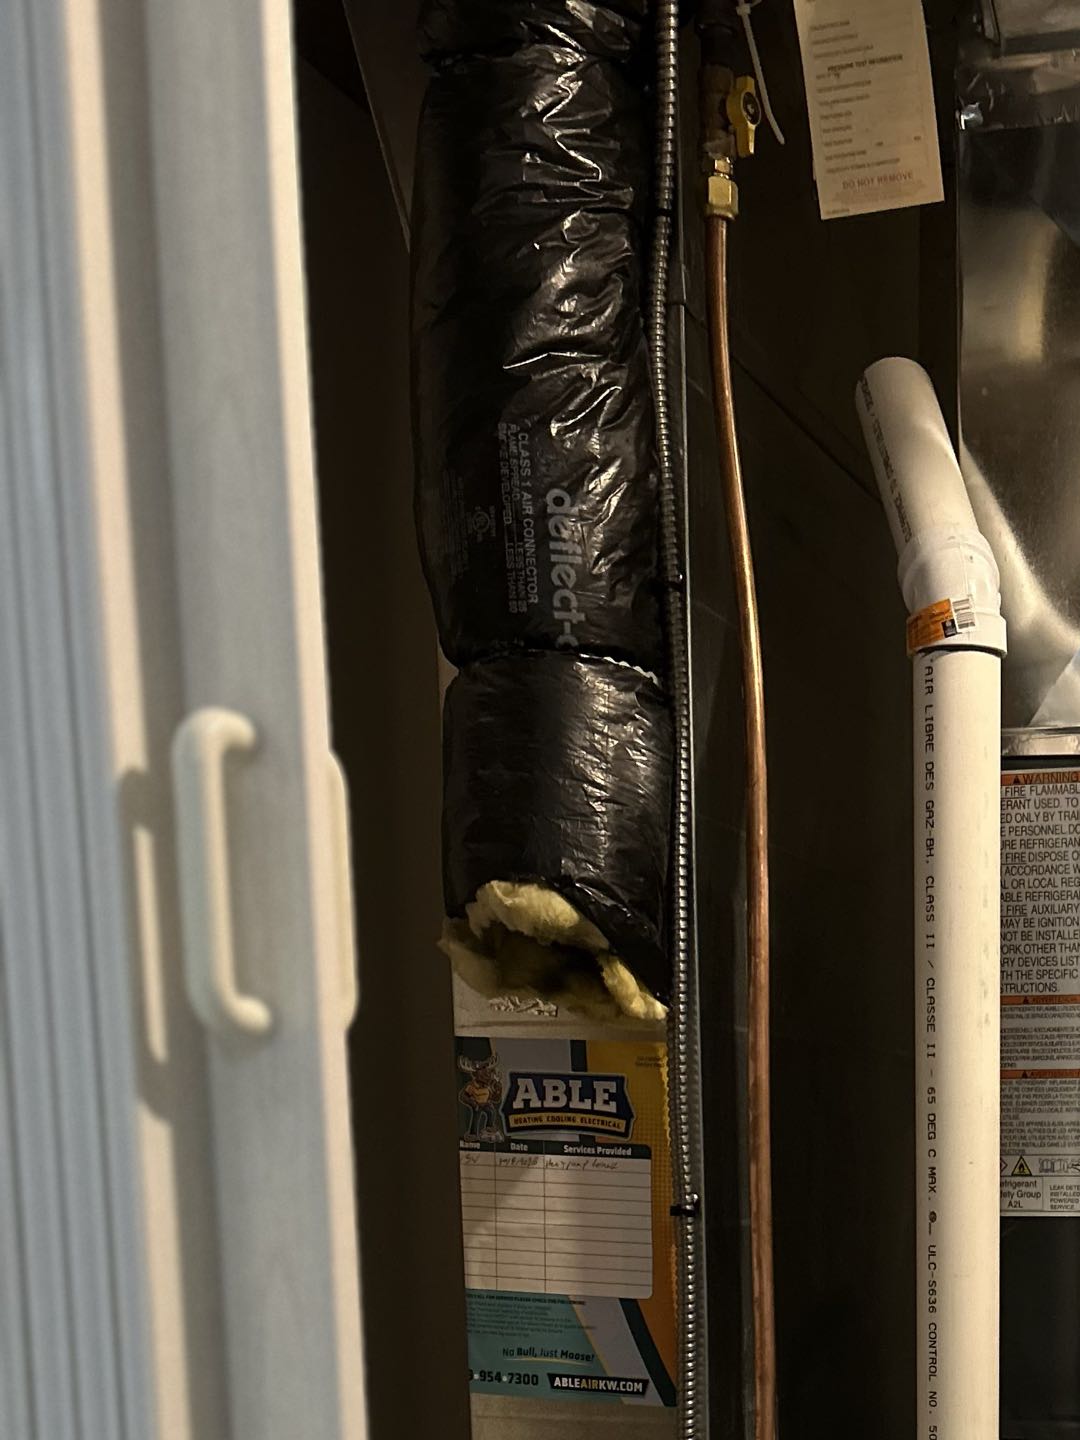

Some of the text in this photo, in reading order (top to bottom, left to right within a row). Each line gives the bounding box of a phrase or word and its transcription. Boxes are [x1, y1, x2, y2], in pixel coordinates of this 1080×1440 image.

[518, 433, 531, 476] CLASS
[522, 492, 533, 515] AIR
[523, 518, 538, 604] CONNECTOR
[925, 704, 935, 753] LIBRE
[925, 761, 935, 791] DES
[1022, 772, 1080, 784] WARNING
[1005, 786, 1026, 797] FIRE
[1065, 797, 1078, 808] TO
[1014, 811, 1041, 823] ONLY
[1043, 810, 1056, 822] BY
[1008, 824, 1068, 837] PERSONNEL
[1005, 852, 1027, 864] FIRE
[1028, 850, 1069, 863] DISPOSE
[1005, 863, 1070, 877] ACCORDANCE
[1011, 879, 1025, 889] OR
[1028, 878, 1058, 889] LOCAL
[925, 875, 935, 922] CLASS
[1006, 905, 1027, 915] FIRE
[1031, 903, 1080, 915] AUXILIARY
[1000, 918, 1020, 929] MAY
[1023, 917, 1036, 928] BE
[1038, 916, 1080, 928] IGNITION
[926, 933, 935, 949] II
[1021, 930, 1033, 941] BE
[1023, 943, 1057, 954] OTHER
[1017, 956, 1059, 967] DEVICES
[1015, 970, 1034, 981] THE
[1035, 968, 1079, 980] SPECIFIC
[926, 977, 936, 1033] CLASSE
[926, 1043, 936, 1059] II
[512, 1078, 617, 1114] ABLE
[927, 1086, 936, 1104] 65
[927, 1112, 937, 1141] DEG
[510, 1143, 528, 1151] Date
[563, 1145, 596, 1154] Services
[597, 1147, 632, 1156] Provided
[927, 1148, 937, 1158] C
[1016, 1190, 1042, 1199] Group
[1007, 1201, 1023, 1209] A2L
[927, 1244, 937, 1313] ULC-S636
[502, 1348, 515, 1356] No
[540, 1348, 558, 1358] Just
[560, 1350, 595, 1362] Moose!
[928, 1323, 938, 1381] CONTROL
[553, 1376, 643, 1393] ABLEAIRKW.COM
